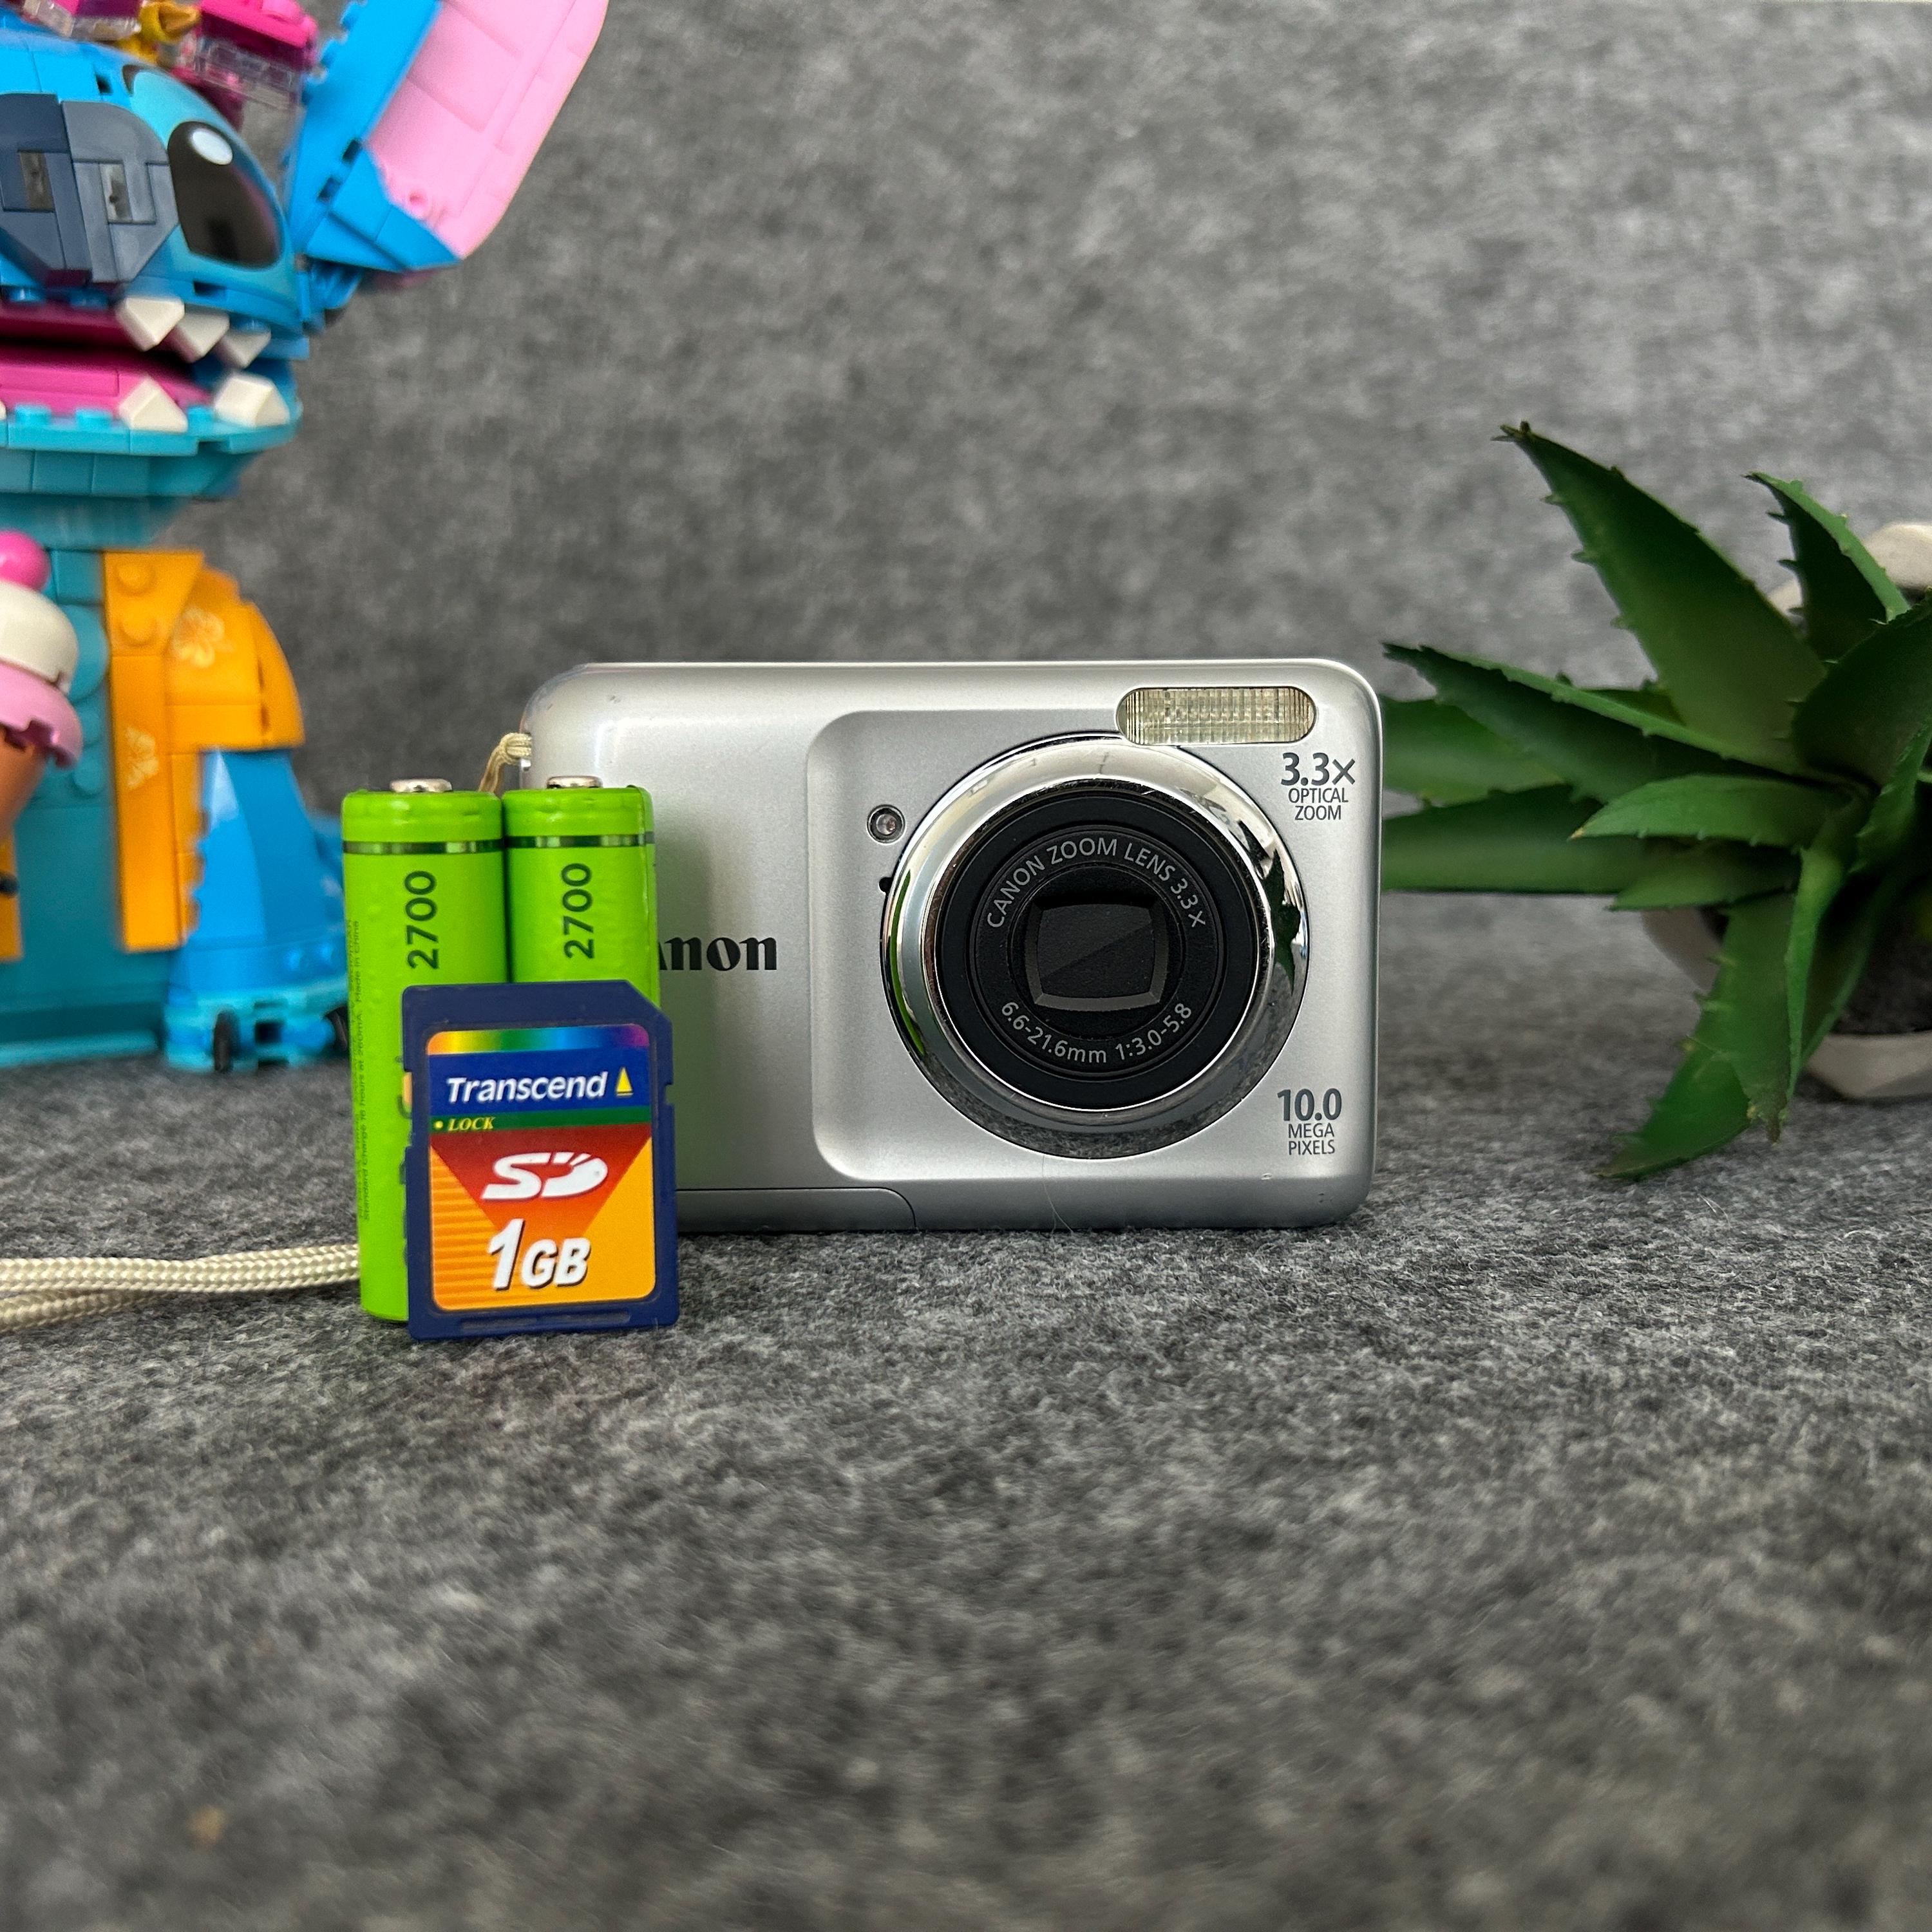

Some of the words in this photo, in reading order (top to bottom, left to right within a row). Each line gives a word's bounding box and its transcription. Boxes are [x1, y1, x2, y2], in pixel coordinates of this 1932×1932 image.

[1288, 788, 1349, 803] OPTICAL
[1294, 805, 1341, 820] ZOOM
[987, 855, 1045, 928] CANON
[1046, 837, 1117, 866] ZOOM
[1124, 842, 1176, 881] LENS
[404, 871, 439, 970] 2700
[561, 863, 595, 960] 2700
[658, 937, 777, 971] non
[1001, 1002, 1106, 1063] 6.6-21.6mm
[1115, 1003, 1191, 1059] 1:3.0-5.8
[446, 1071, 608, 1103] Transcend
[1277, 1088, 1342, 1121] 10.0
[448, 1117, 495, 1132] LOCK
[1288, 1122, 1334, 1138] MEGA
[1289, 1139, 1335, 1155] PIXELS
[481, 1151, 608, 1200] SD
[488, 1218, 591, 1291] 1GB
